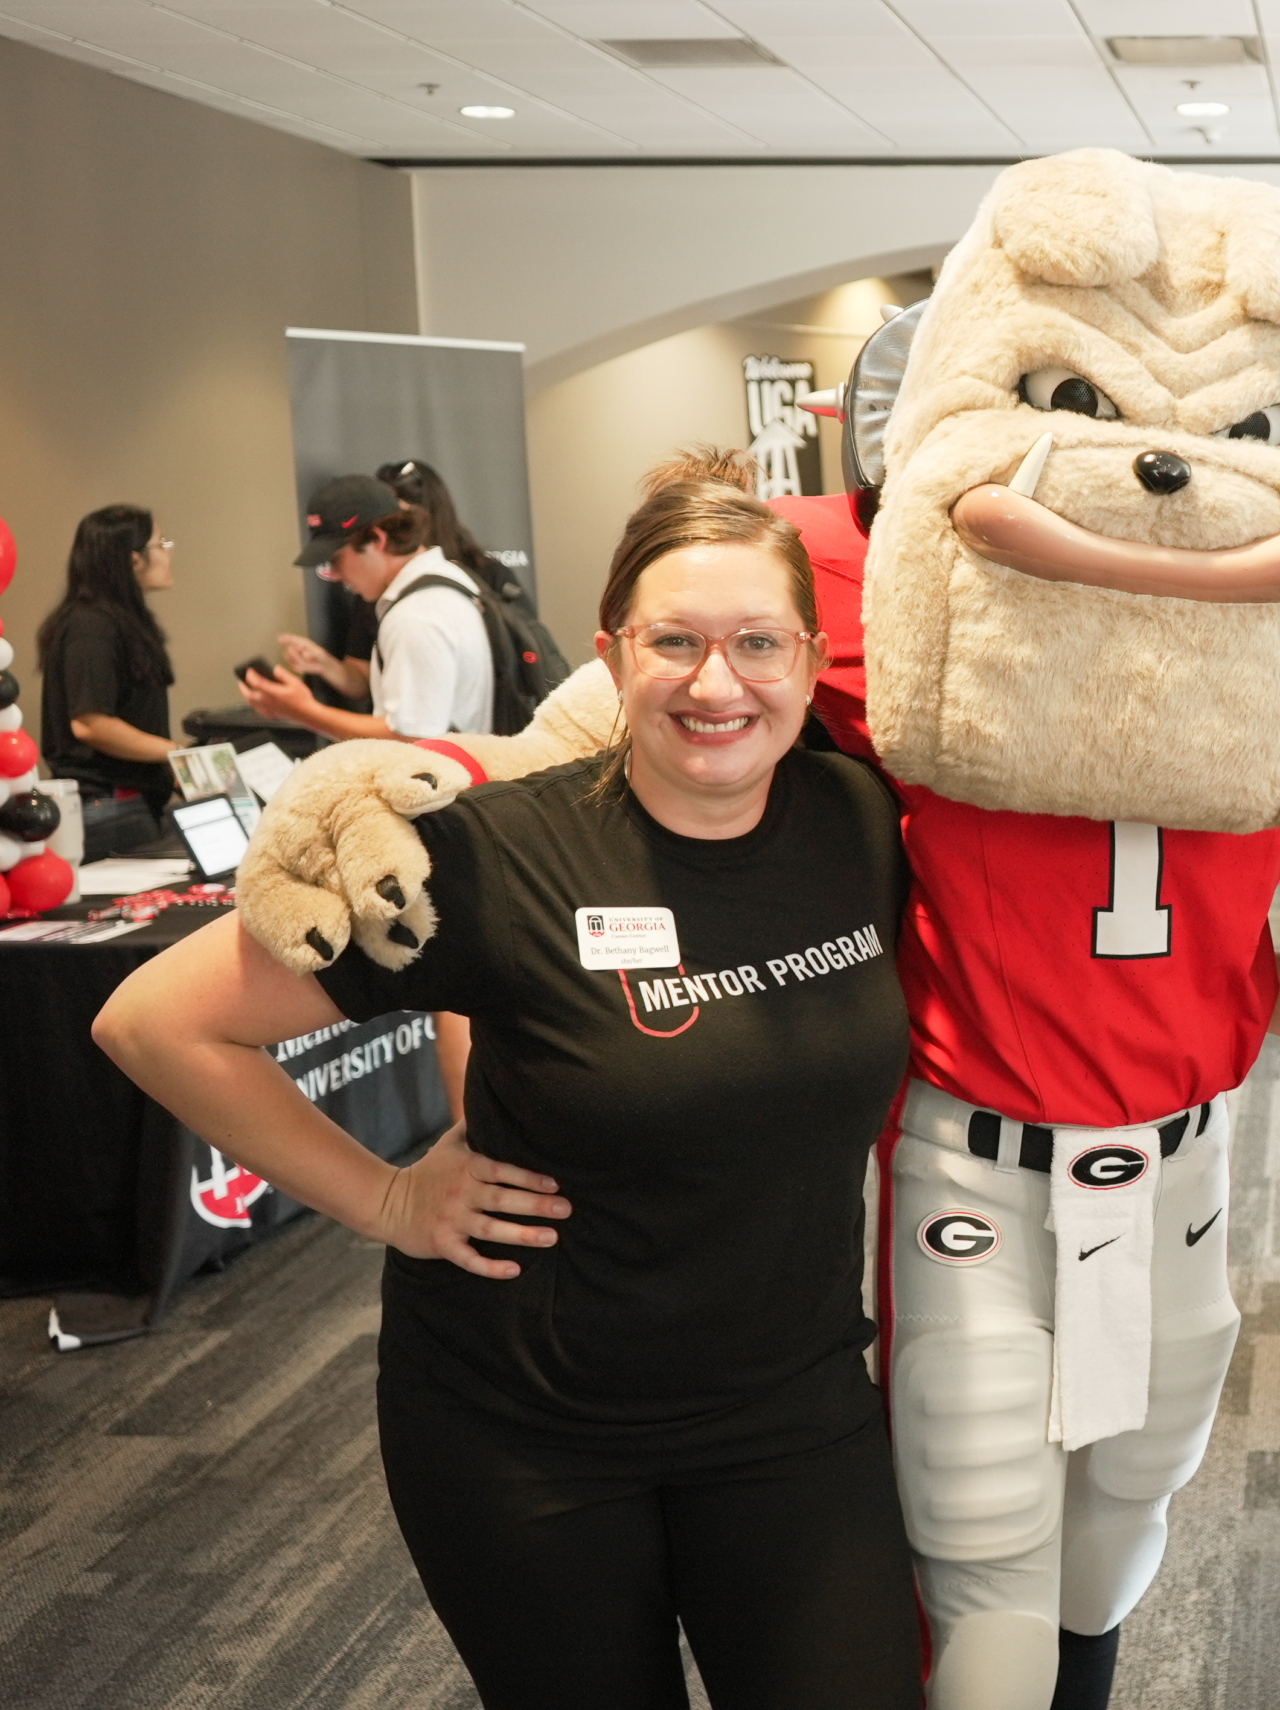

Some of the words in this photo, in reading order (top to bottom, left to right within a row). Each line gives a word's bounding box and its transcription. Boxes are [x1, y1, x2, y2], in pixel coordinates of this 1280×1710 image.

[1091, 820, 1172, 960] 1
[591, 947, 603, 955] Dr.
[605, 946, 637, 955] Bethany
[639, 945, 670, 955] Bagwell
[609, 922, 666, 932] GEORGIA
[638, 965, 767, 1013] MENTOR
[766, 924, 884, 987] PROGRAM
[295, 1031, 396, 1102] NIVERSITY
[396, 1017, 424, 1055] OF
[922, 1212, 999, 1261] G
